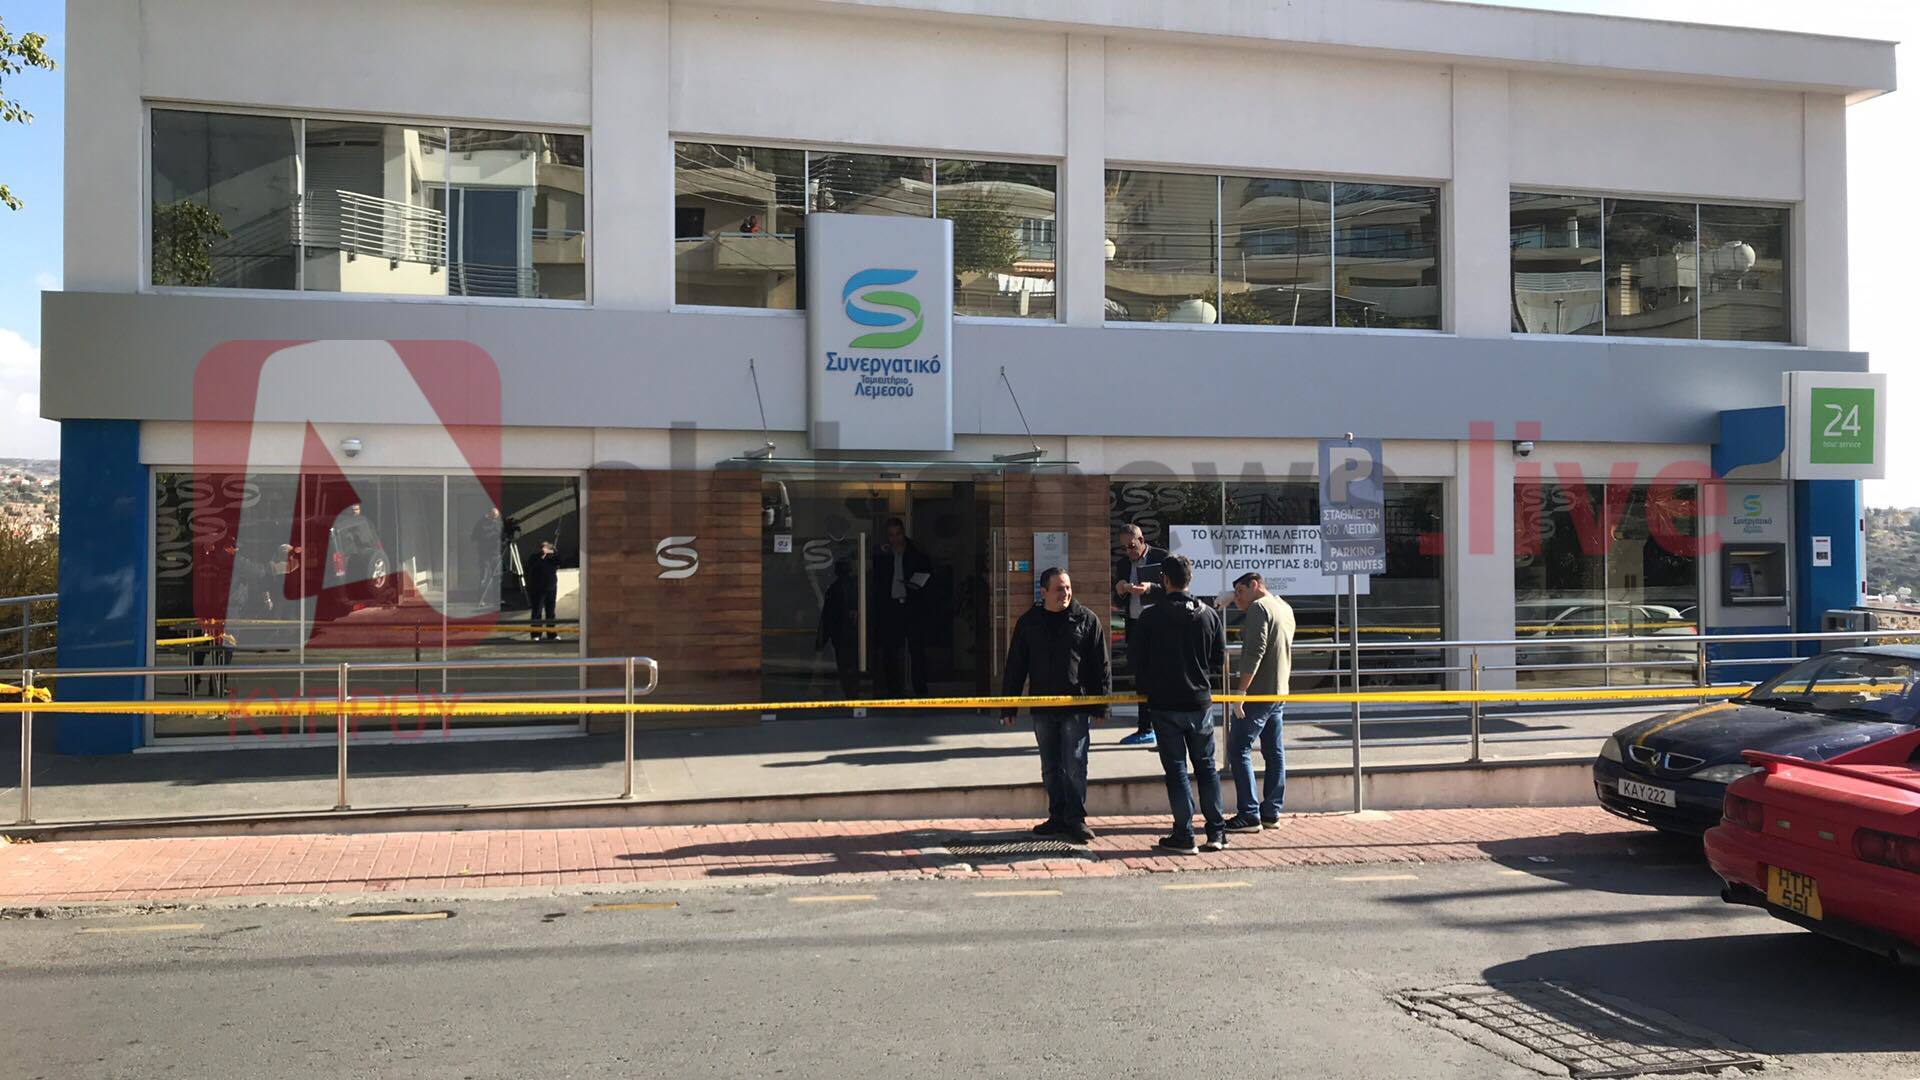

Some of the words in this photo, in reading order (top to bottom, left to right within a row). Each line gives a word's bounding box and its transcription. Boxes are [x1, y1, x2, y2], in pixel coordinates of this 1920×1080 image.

[825, 351, 941, 376] Συνεργατικό
[860, 374, 909, 386] Ταμιευτήριο
[854, 381, 914, 400] Λεμεσού
[1823, 403, 1861, 437] 24
[1329, 447, 1373, 503] P
[1323, 508, 1380, 521] ΣΤΑΘΜΕΥΣΗ
[1192, 529, 1207, 540] ΤΟ
[1210, 529, 1280, 540] ΚΑΤΑΣΤΗΜΑ
[1326, 524, 1339, 536] 30
[1343, 523, 1380, 535] ΛΕΠΤΩΝ
[1330, 546, 1376, 558] PARKING
[1225, 559, 1300, 570] ΛΕΙΤΟΥΡΓΙΑΣ
[1323, 561, 1338, 572] 30
[1342, 559, 1384, 571] MINUTES
[1624, 781, 1646, 796] KAY
[1647, 787, 1667, 804] 222
[1778, 868, 1813, 897] HTH
